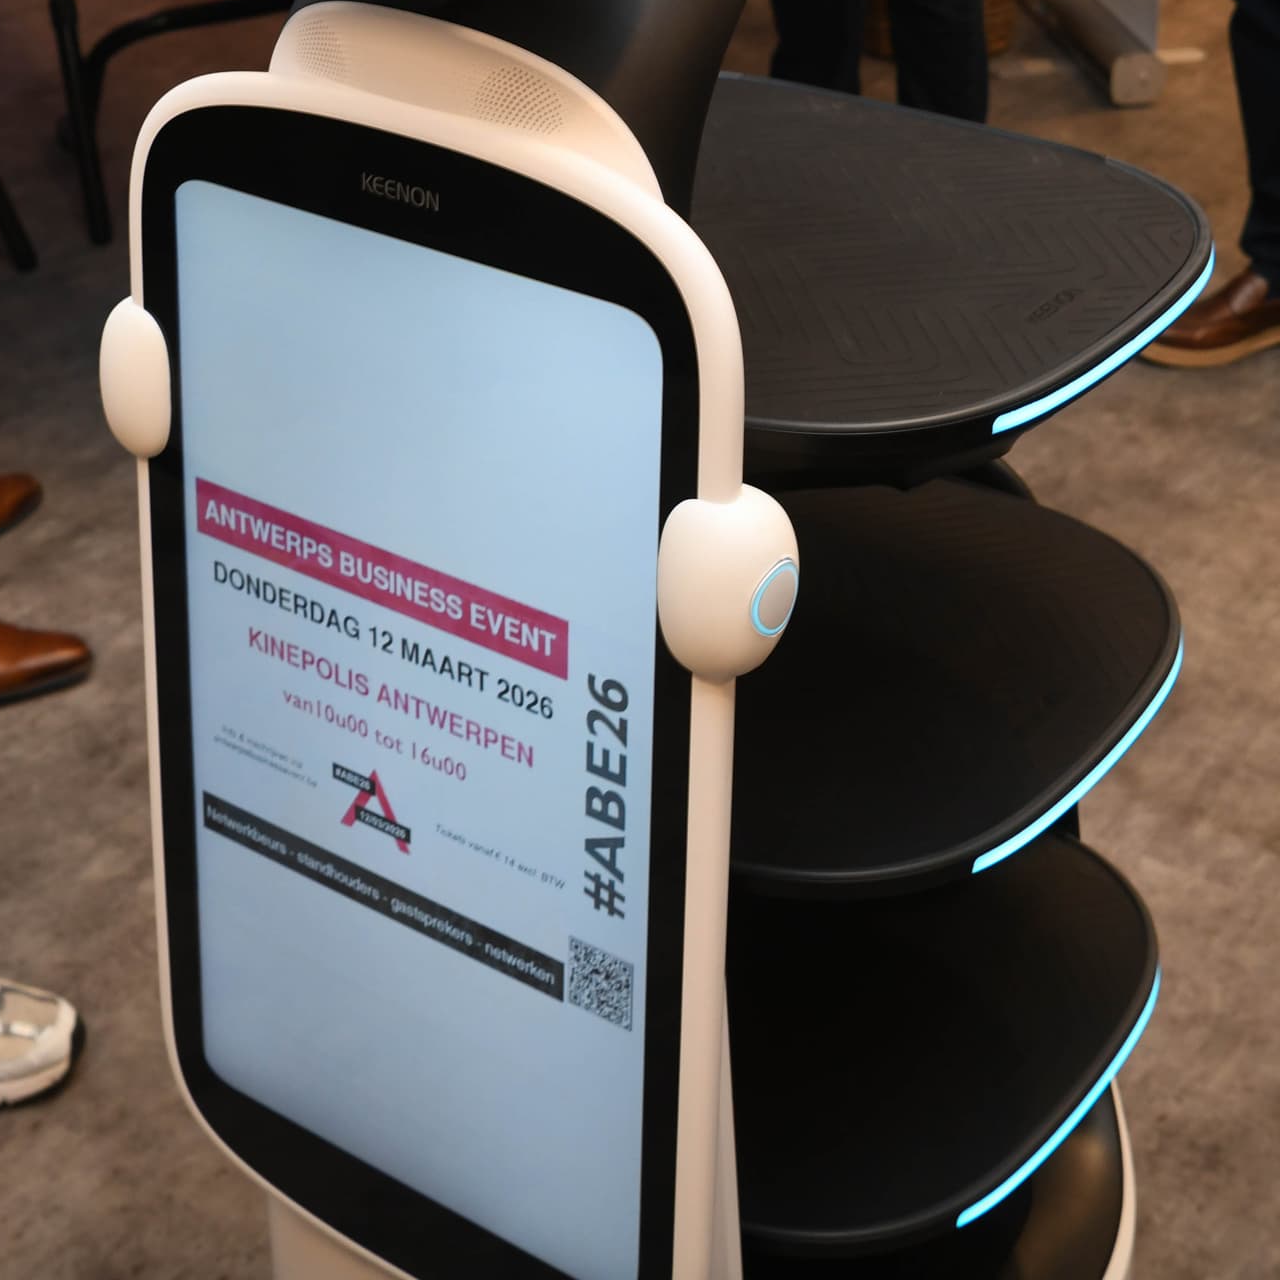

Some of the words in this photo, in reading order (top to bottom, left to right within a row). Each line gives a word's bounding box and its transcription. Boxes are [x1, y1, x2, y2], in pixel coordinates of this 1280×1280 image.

[361, 171, 440, 212] KEENON
[205, 499, 333, 568] ANTWERPS
[339, 551, 464, 620] BUSINESS
[470, 602, 557, 657] EVENT
[213, 560, 361, 640] DONDERDAG
[369, 626, 394, 655] 12
[400, 637, 490, 692] MAART
[496, 678, 554, 720] 2026
[248, 626, 370, 696] KINEPOLIS
[377, 683, 535, 769] ANTWERPEN
[374, 728, 403, 755] tot
[411, 742, 467, 782] 16u00
[584, 672, 630, 920] #ABE26
[296, 850, 380, 901] standhouders
